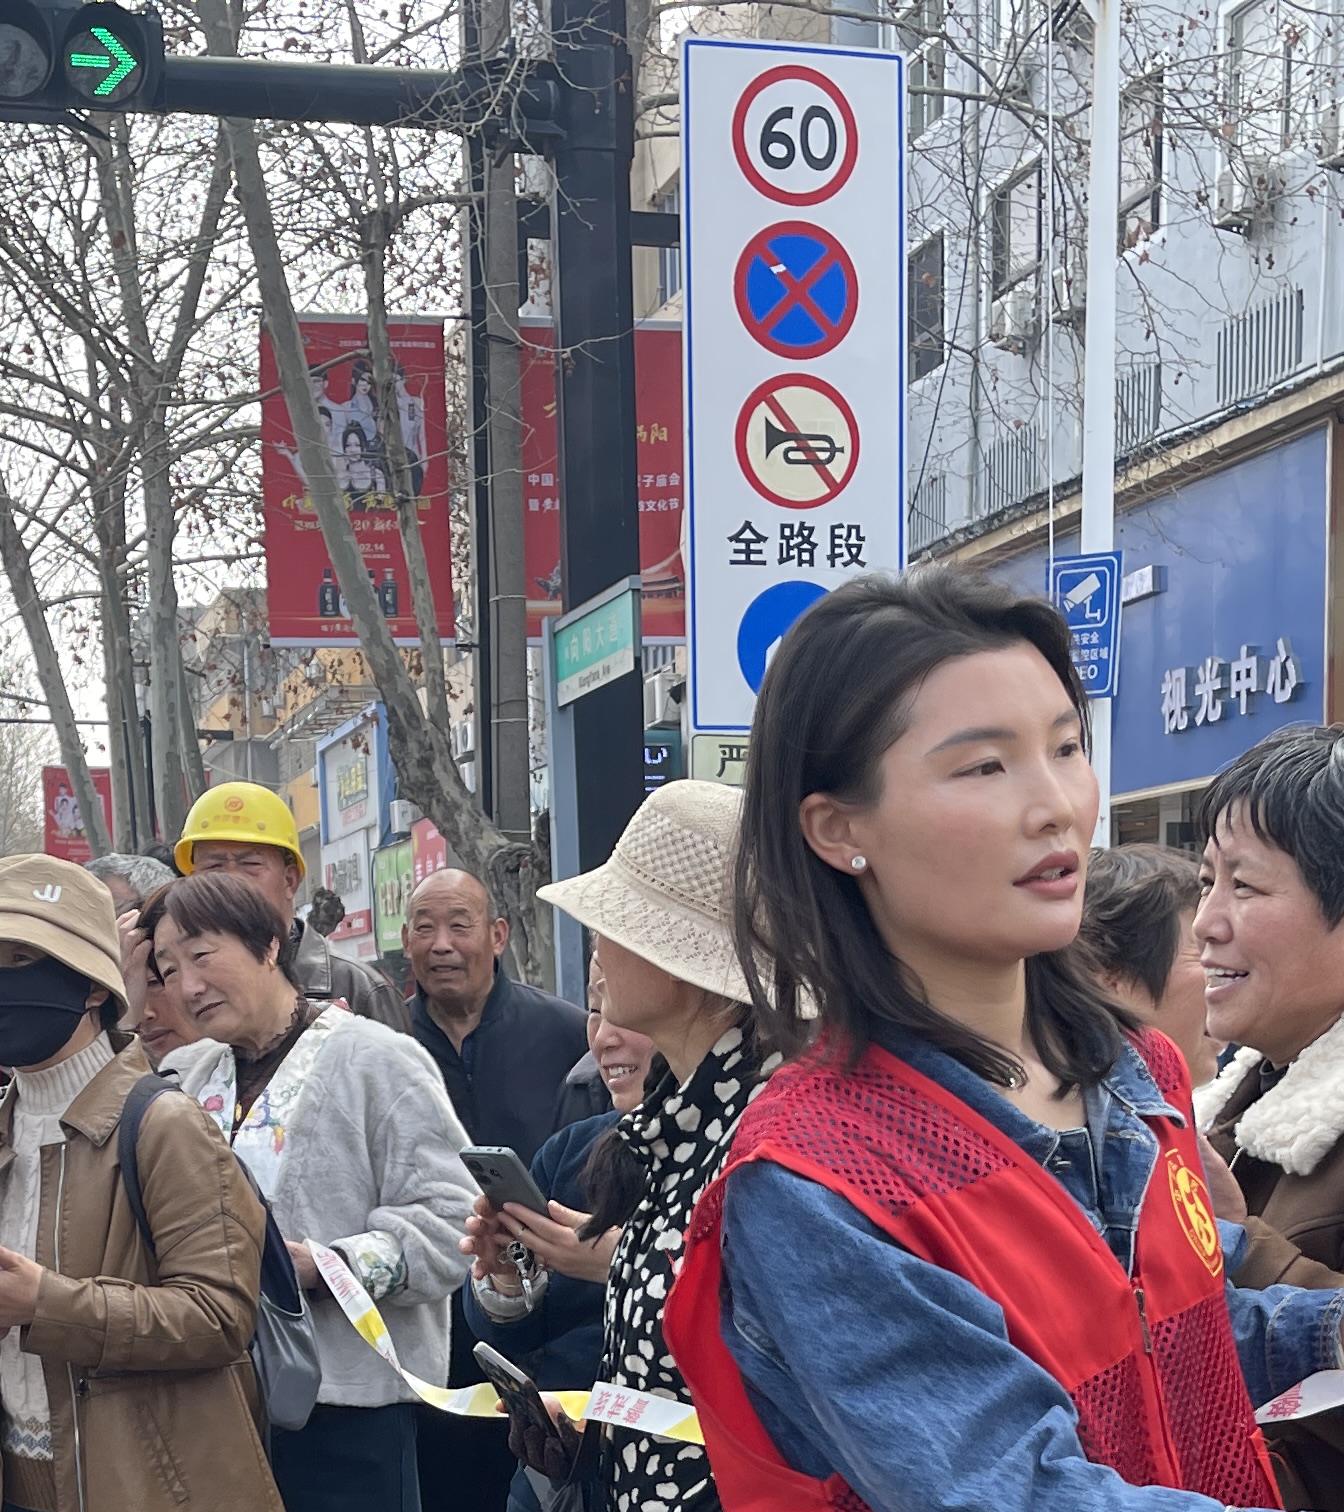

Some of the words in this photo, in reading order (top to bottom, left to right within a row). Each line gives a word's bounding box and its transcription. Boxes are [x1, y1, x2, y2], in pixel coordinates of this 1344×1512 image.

[759, 105, 838, 171] 60
[726, 520, 868, 569] 全路段
[1161, 636, 1304, 735] 视光中心
[592, 1390, 650, 1425] 警戒线
